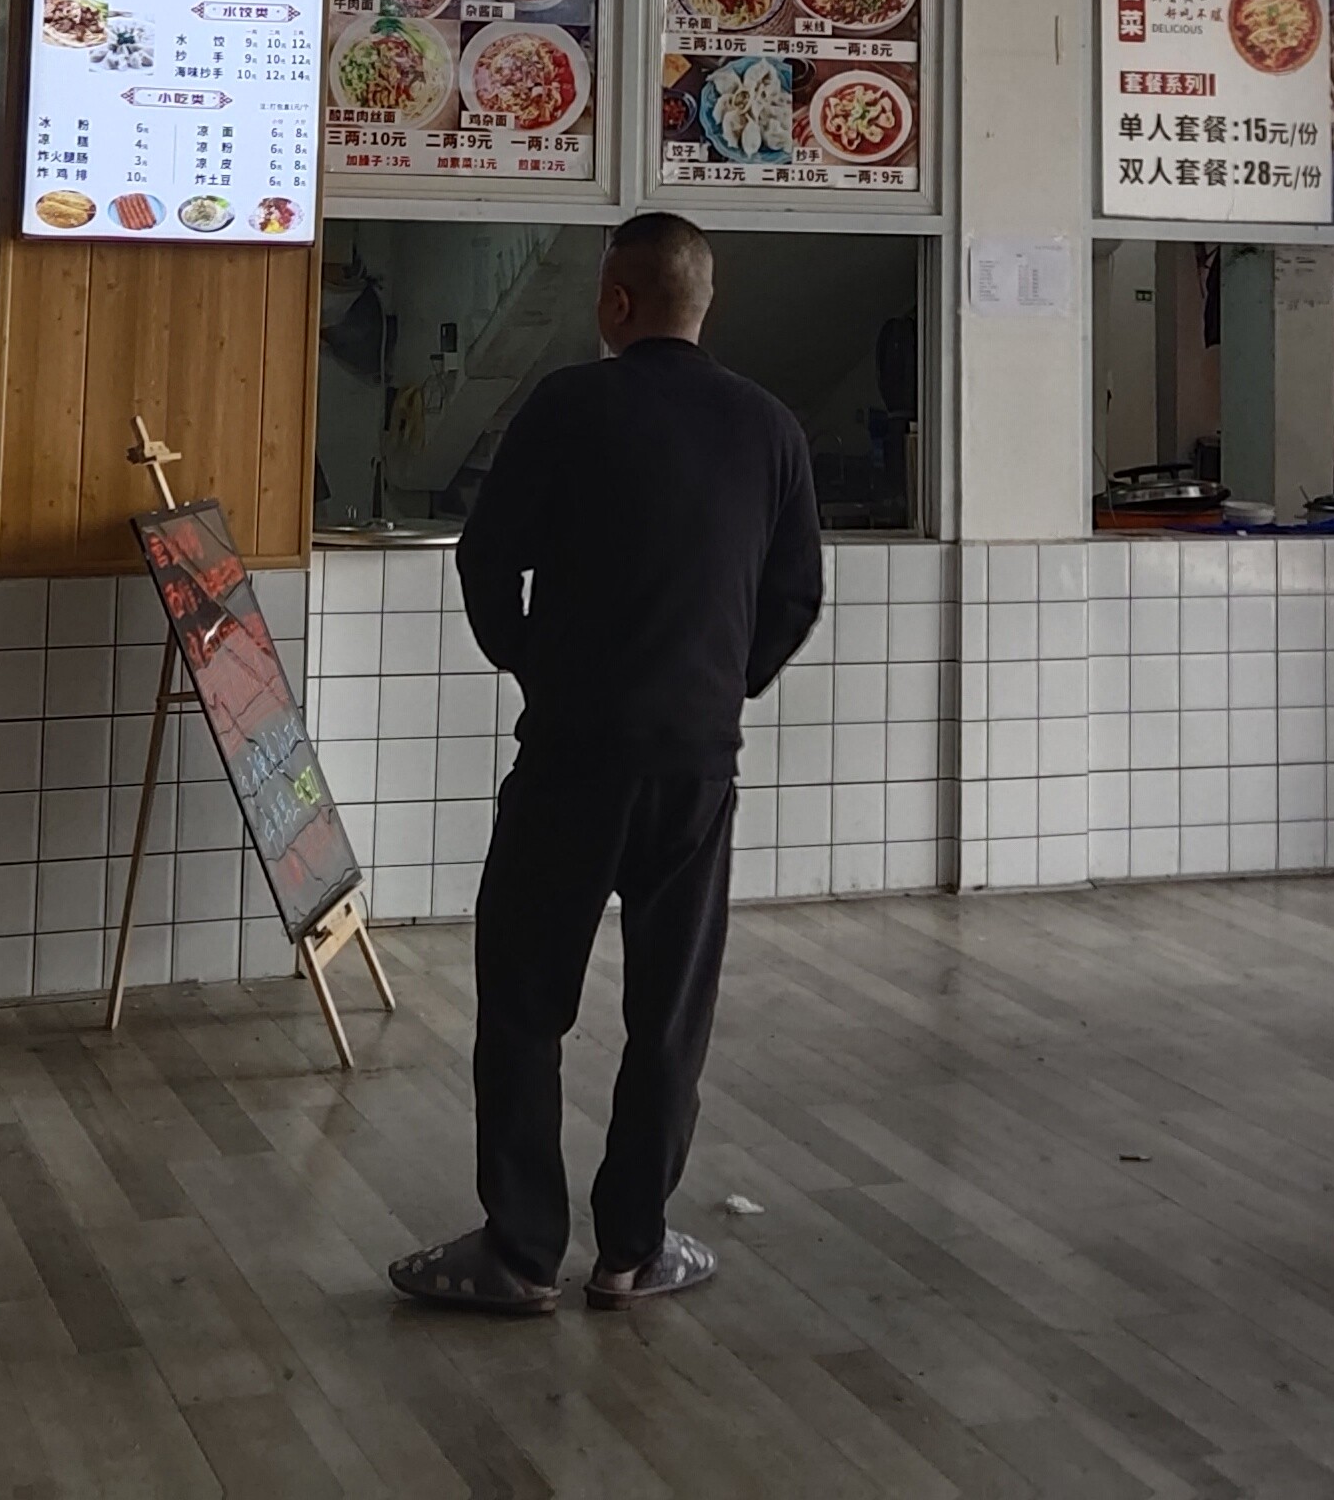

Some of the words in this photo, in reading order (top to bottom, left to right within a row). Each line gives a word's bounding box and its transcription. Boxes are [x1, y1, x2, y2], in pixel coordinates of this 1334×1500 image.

[466, 5, 504, 18] 杂酱面
[802, 20, 826, 33] 米线
[1152, 24, 1203, 34] DELICIOUS
[176, 34, 225, 47] 水饺
[175, 50, 223, 63] 抄手
[1124, 73, 1203, 95] 套餐系列
[157, 92, 205, 105] 小吃类
[328, 110, 396, 124] 酸菜肉丝面
[469, 114, 507, 127] 鸡杂面
[672, 144, 696, 157] 饺子
